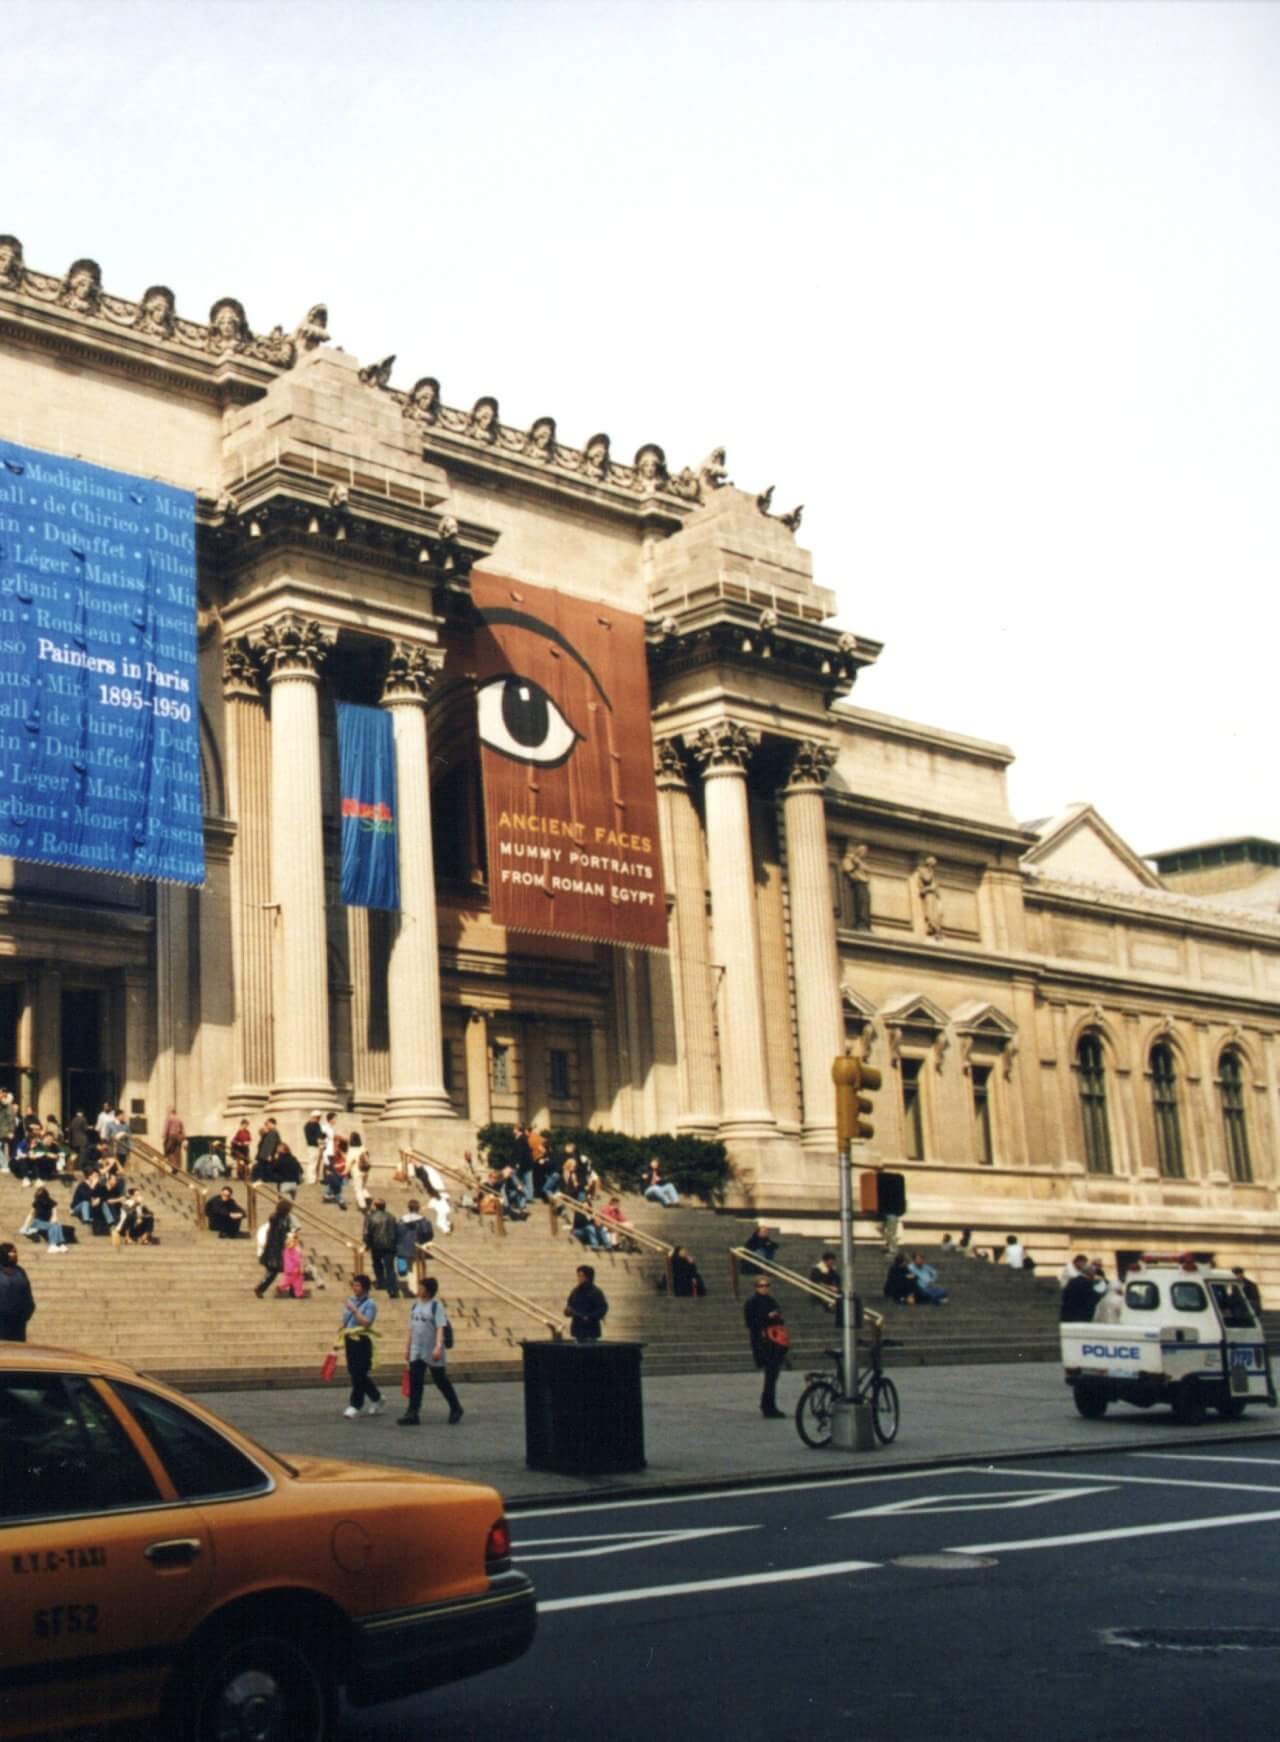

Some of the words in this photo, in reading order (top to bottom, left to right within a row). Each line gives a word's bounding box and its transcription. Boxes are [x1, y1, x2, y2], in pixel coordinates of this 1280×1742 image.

[25, 461, 123, 503] Modigliani
[44, 496, 66, 513] de
[71, 500, 139, 535] Chirico
[15, 543, 69, 573] Léger
[85, 563, 150, 592] Matiss
[37, 607, 121, 645] Rouseau
[38, 637, 115, 675] Painters
[122, 656, 141, 679] in
[146, 661, 190, 693] Paris
[47, 705, 69, 725] de
[87, 777, 151, 804] Matiss
[74, 804, 128, 832] Monet
[499, 811, 585, 838] ANCIENT
[595, 826, 653, 853] FACES
[500, 841, 561, 862] MUMMY
[570, 851, 653, 879] PORTRAITS
[501, 869, 545, 887] FROM
[552, 875, 605, 897] ROMAN
[611, 886, 656, 906] EGYPT
[1082, 1344, 1141, 1360] POLICE
